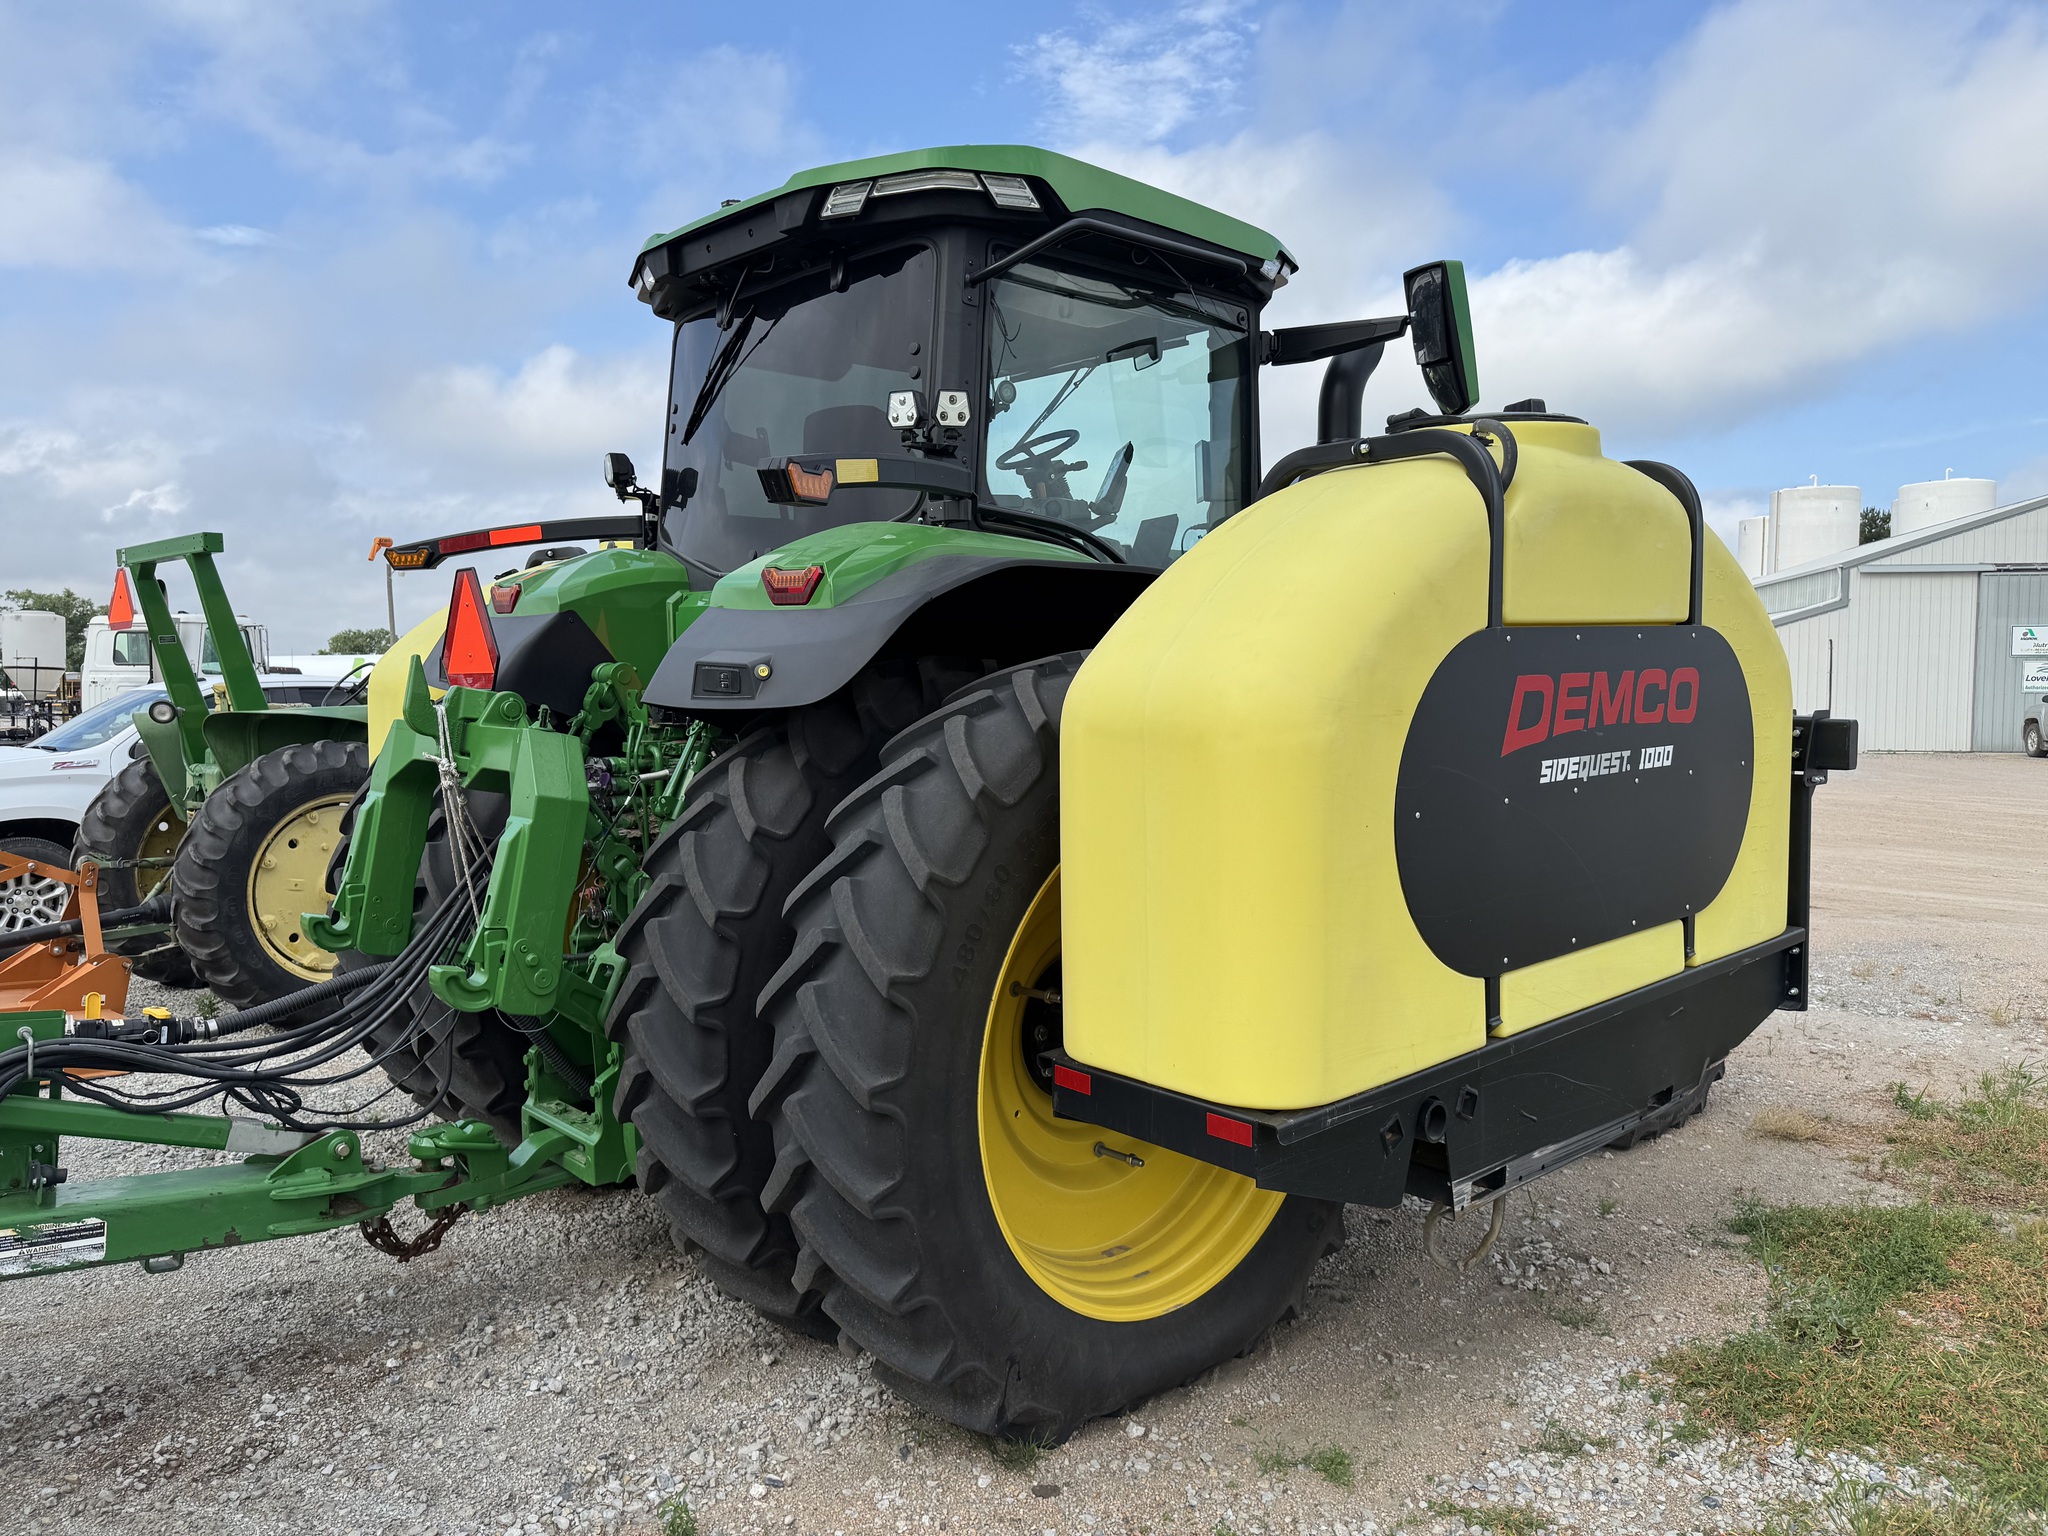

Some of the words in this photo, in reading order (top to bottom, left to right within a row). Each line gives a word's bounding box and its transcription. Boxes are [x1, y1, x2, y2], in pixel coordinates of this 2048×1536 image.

[1501, 667, 1700, 757] DEMCO
[1540, 750, 1631, 784] SIDEQUEST
[1639, 745, 1673, 769] 1000
[26, 1244, 63, 1255] WARNING
